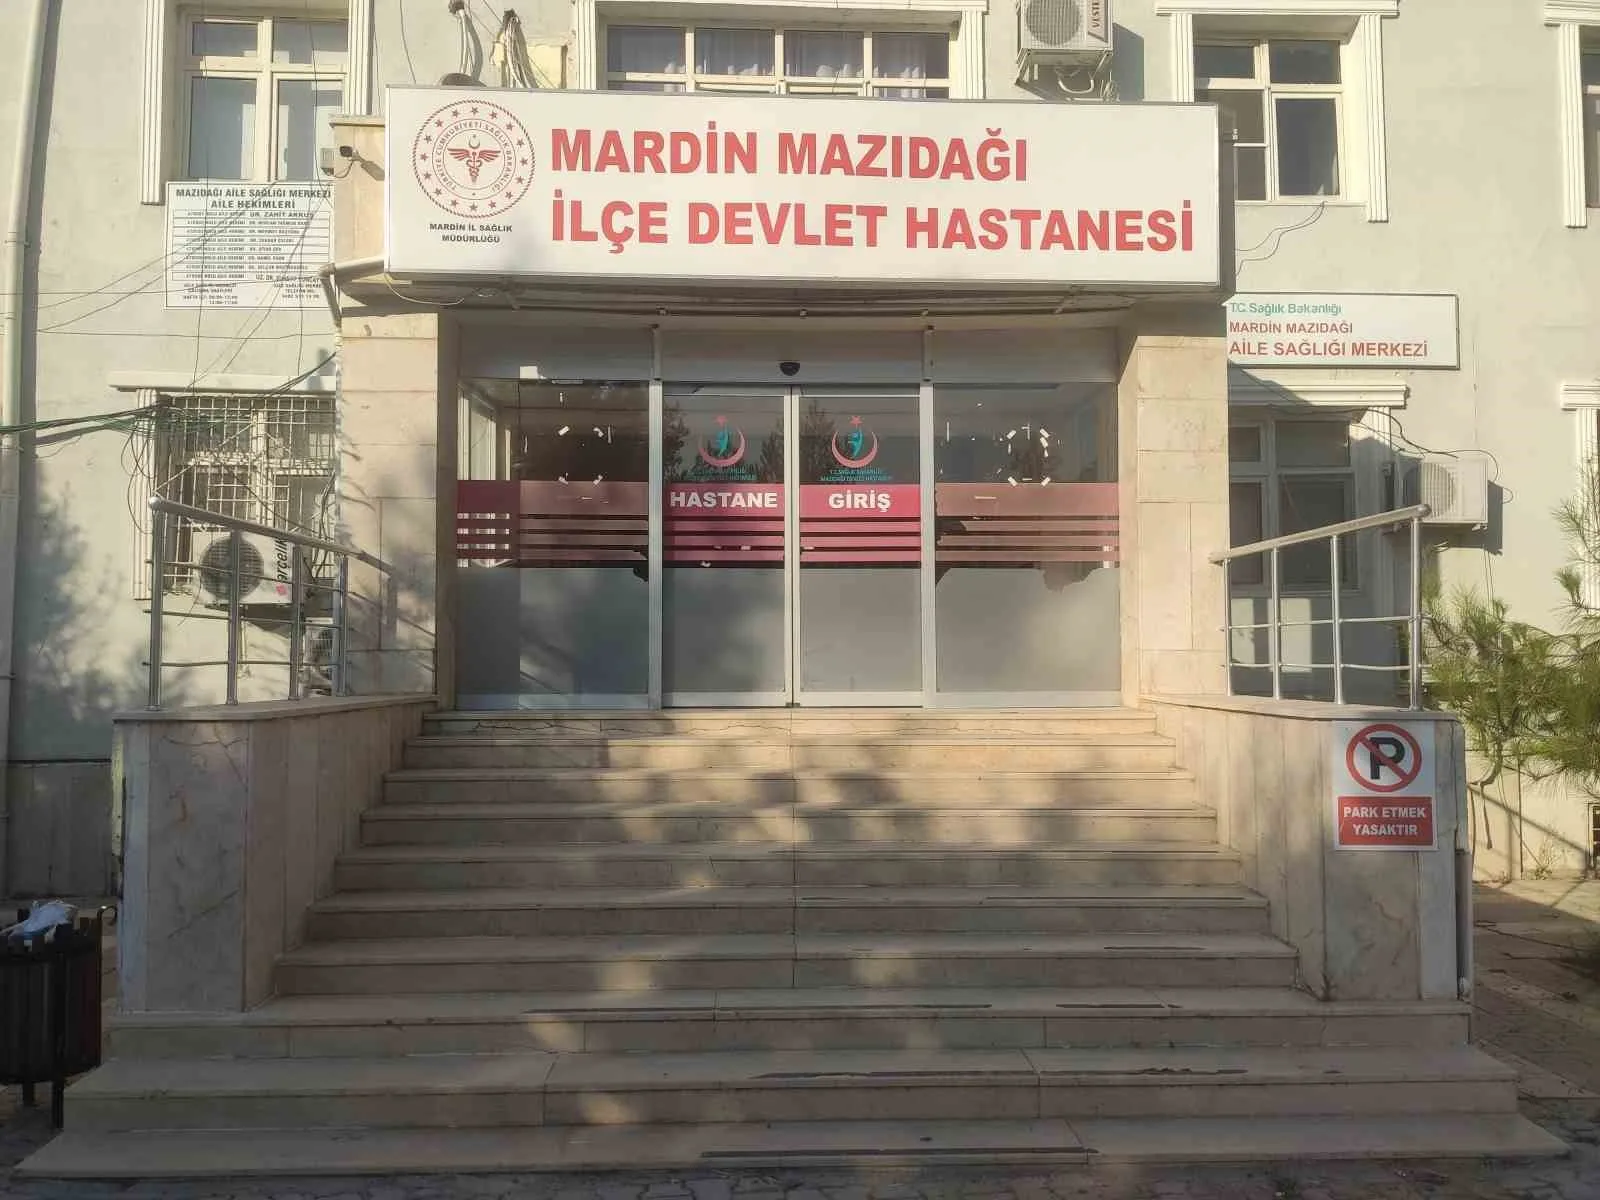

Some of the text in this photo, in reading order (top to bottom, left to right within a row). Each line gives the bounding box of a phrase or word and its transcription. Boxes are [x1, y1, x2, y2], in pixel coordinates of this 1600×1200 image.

[551, 121, 1027, 181] MARDİN MAZIDAĞI
[176, 187, 222, 197] MAZIDAĞI
[225, 187, 246, 197] AİLE
[249, 188, 286, 198] SAĞLIĞI
[210, 199, 296, 209] AİLE HEKİMLERİ
[429, 222, 513, 233] MARDİN İL SAĞLIK
[552, 189, 1192, 254] İLÇE DEVLET HASTANESİ
[441, 233, 500, 244] MÜDÜRLÜĞÜ
[1249, 303, 1285, 316] Sağlık
[1288, 303, 1342, 316] Bakanlığı
[1229, 321, 1353, 335] MARDİN MAZIDAĞI
[1229, 339, 1428, 357] AİLE SAĞLIĞI MERKEZİ
[670, 489, 891, 513] HASTANE GİRİŞ
[1370, 737, 1405, 779] P
[1343, 806, 1426, 818] PARK ETMEK
[1352, 823, 1419, 836] YASAKTIR
